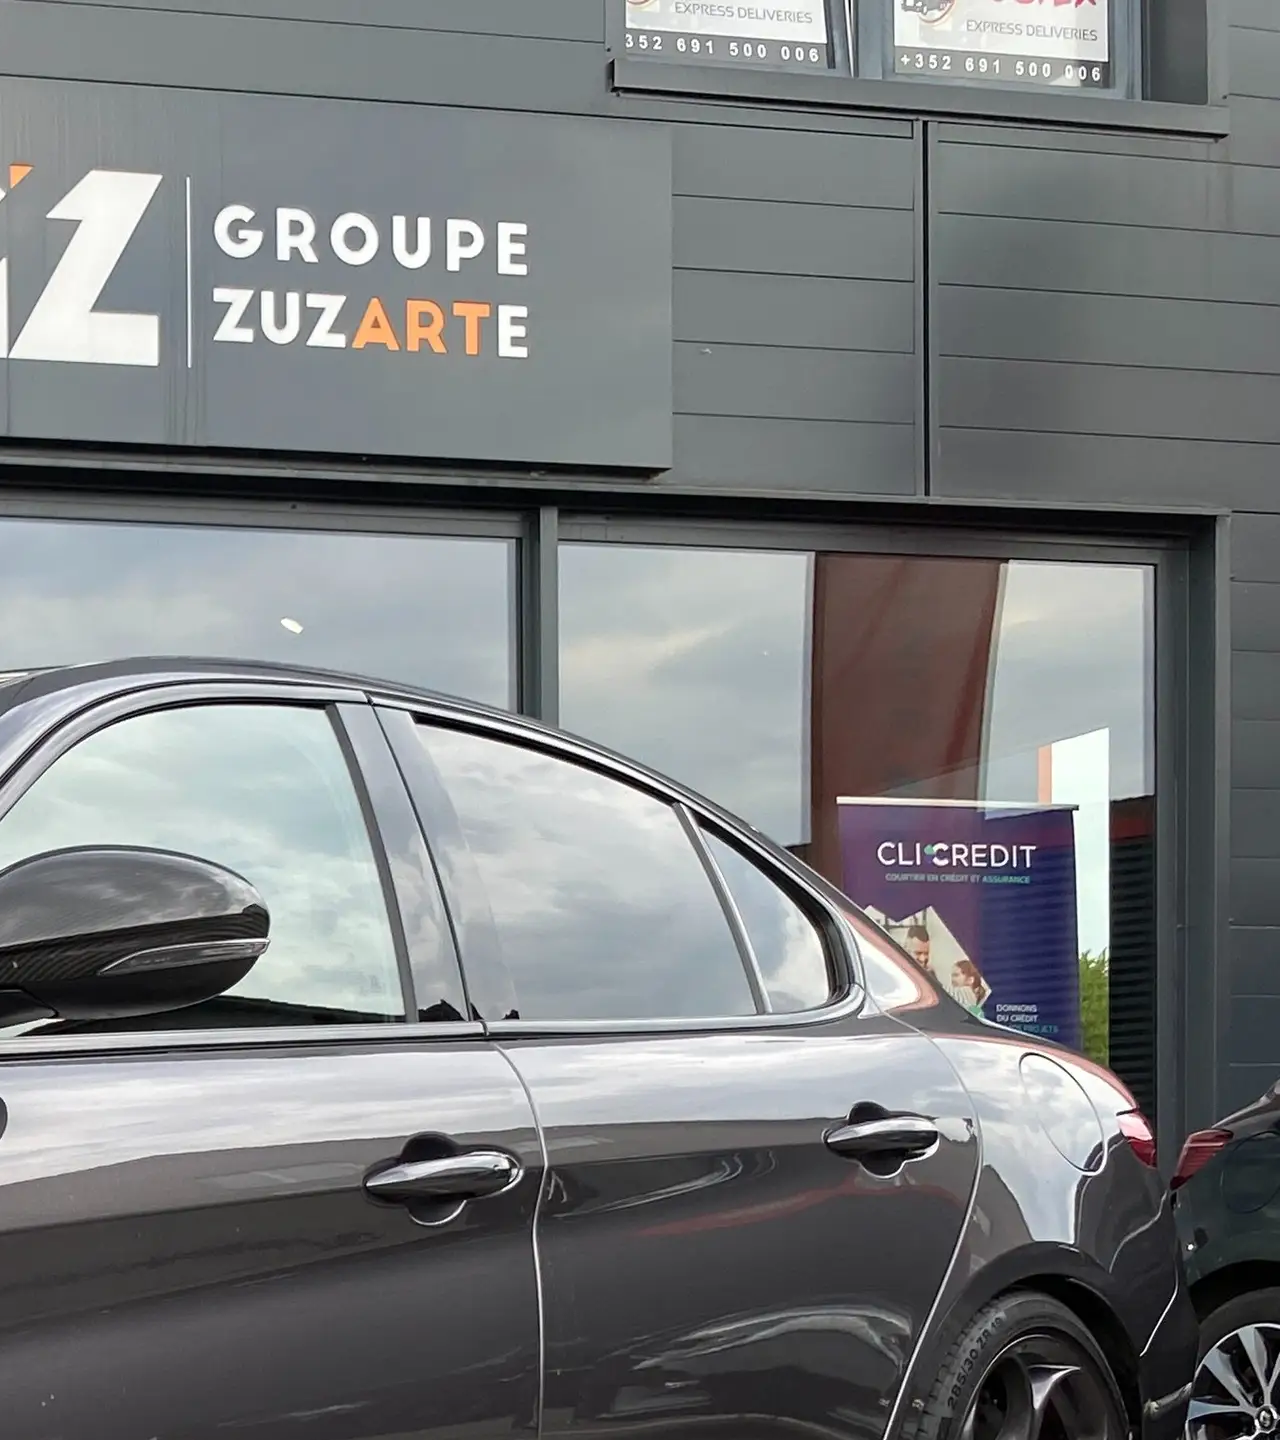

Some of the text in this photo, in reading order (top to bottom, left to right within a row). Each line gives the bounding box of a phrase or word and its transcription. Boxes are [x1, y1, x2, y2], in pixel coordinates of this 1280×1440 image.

[675, 3, 813, 23] EXPRESS DELIVERIES
[966, 20, 1098, 41] EXPRESS DELIVERIES
[677, 37, 714, 54] 691
[729, 42, 767, 58] 500
[780, 46, 819, 62] 006
[901, 54, 1101, 81] +352 691 500 006
[213, 204, 530, 277] GROUPE
[213, 287, 530, 359] ZUZARTE
[982, 875, 1031, 884] ASSURANCE
